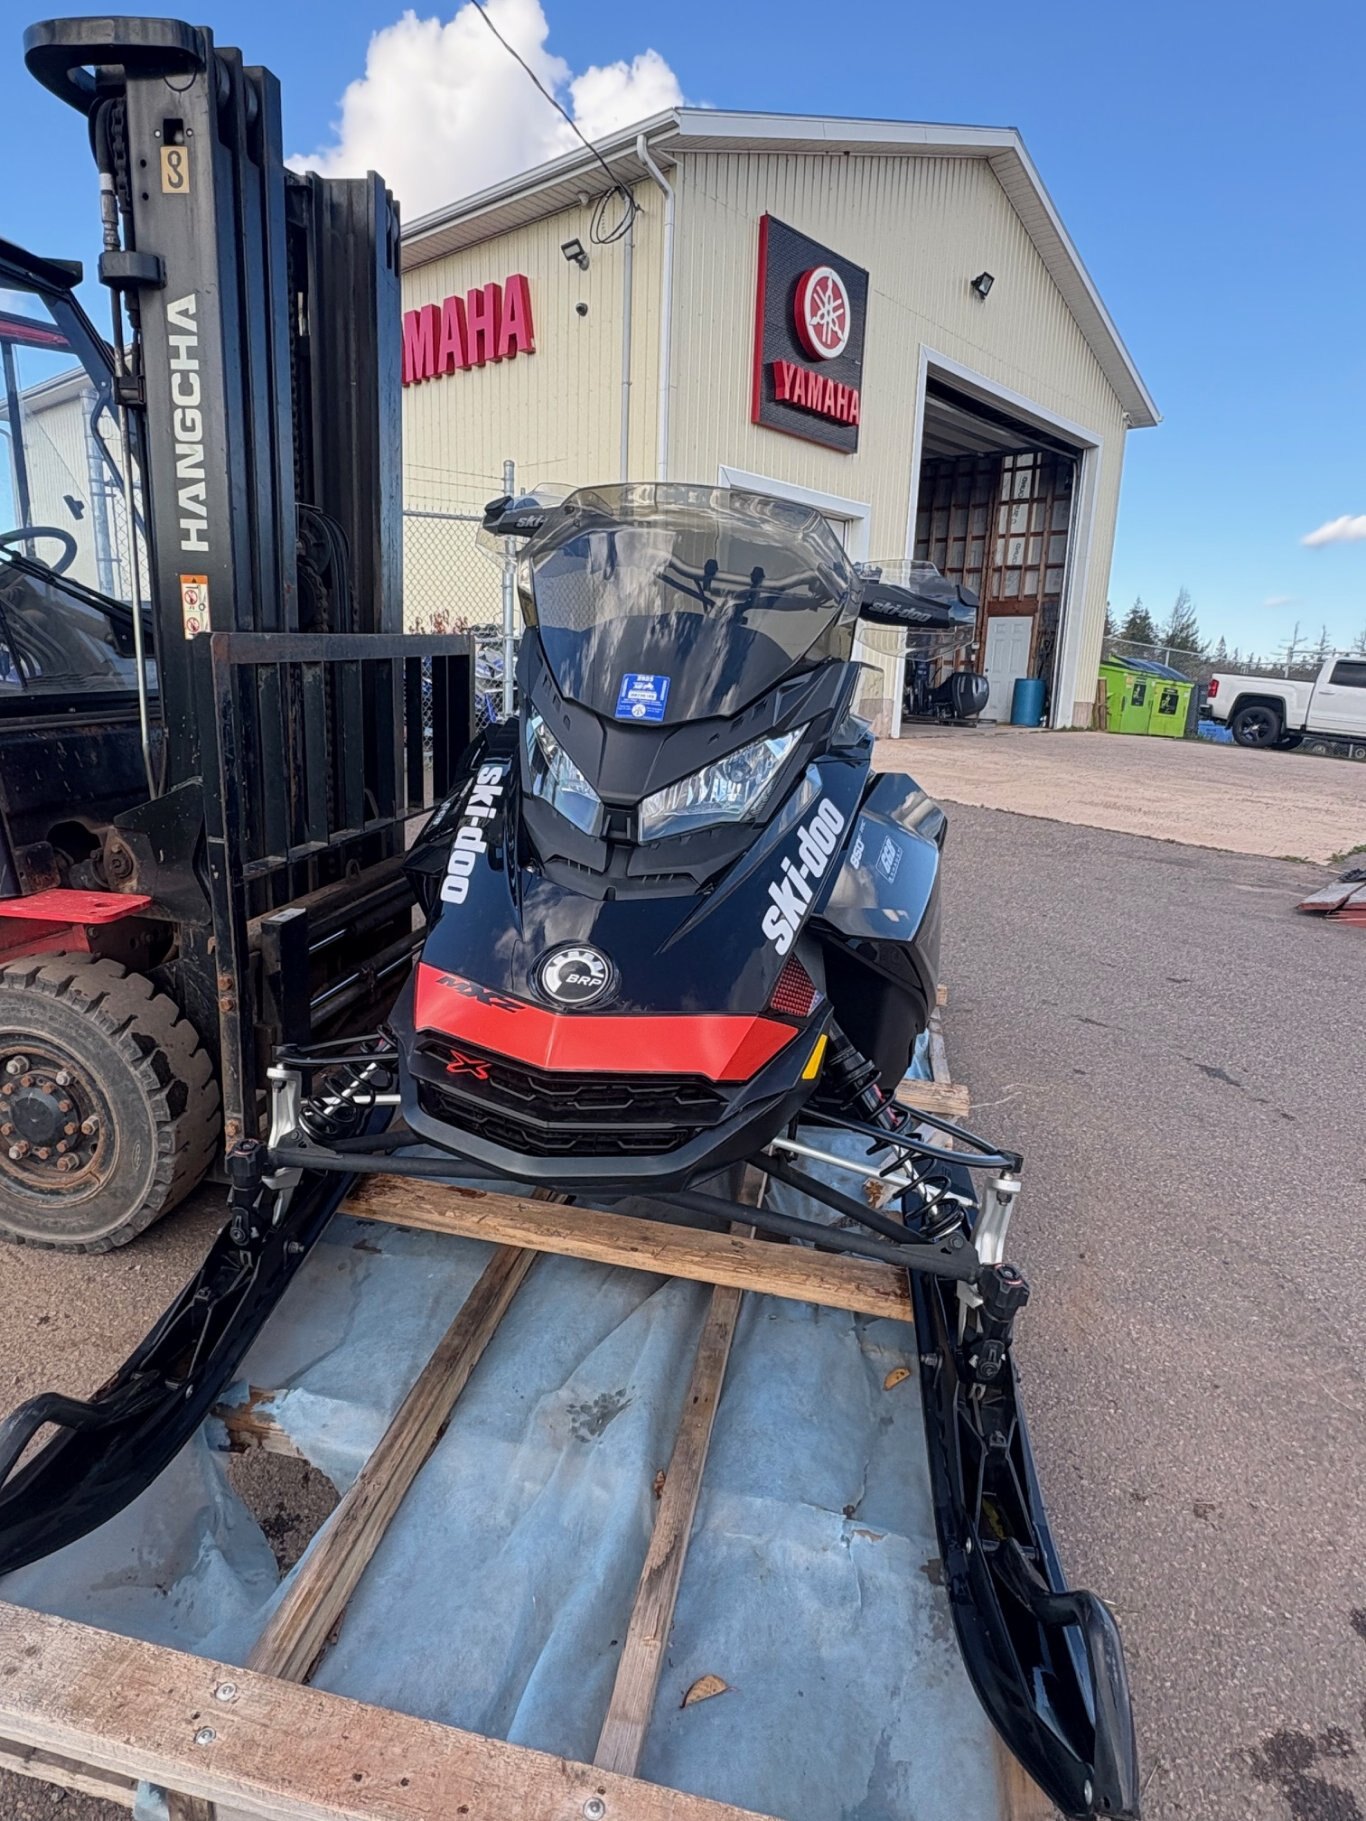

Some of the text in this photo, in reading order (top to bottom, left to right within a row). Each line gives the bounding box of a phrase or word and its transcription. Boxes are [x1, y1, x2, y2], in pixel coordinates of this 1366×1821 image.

[402, 273, 535, 388] MAHA
[167, 293, 209, 552] HANGCHA
[775, 359, 860, 427] YAMAHA
[868, 600, 933, 623] ski-doo
[440, 766, 504, 905] ski-doo
[850, 838, 864, 869] 850
[761, 797, 845, 956] ski-doo
[435, 975, 527, 1014] MXZ
[565, 973, 602, 987] BRP
